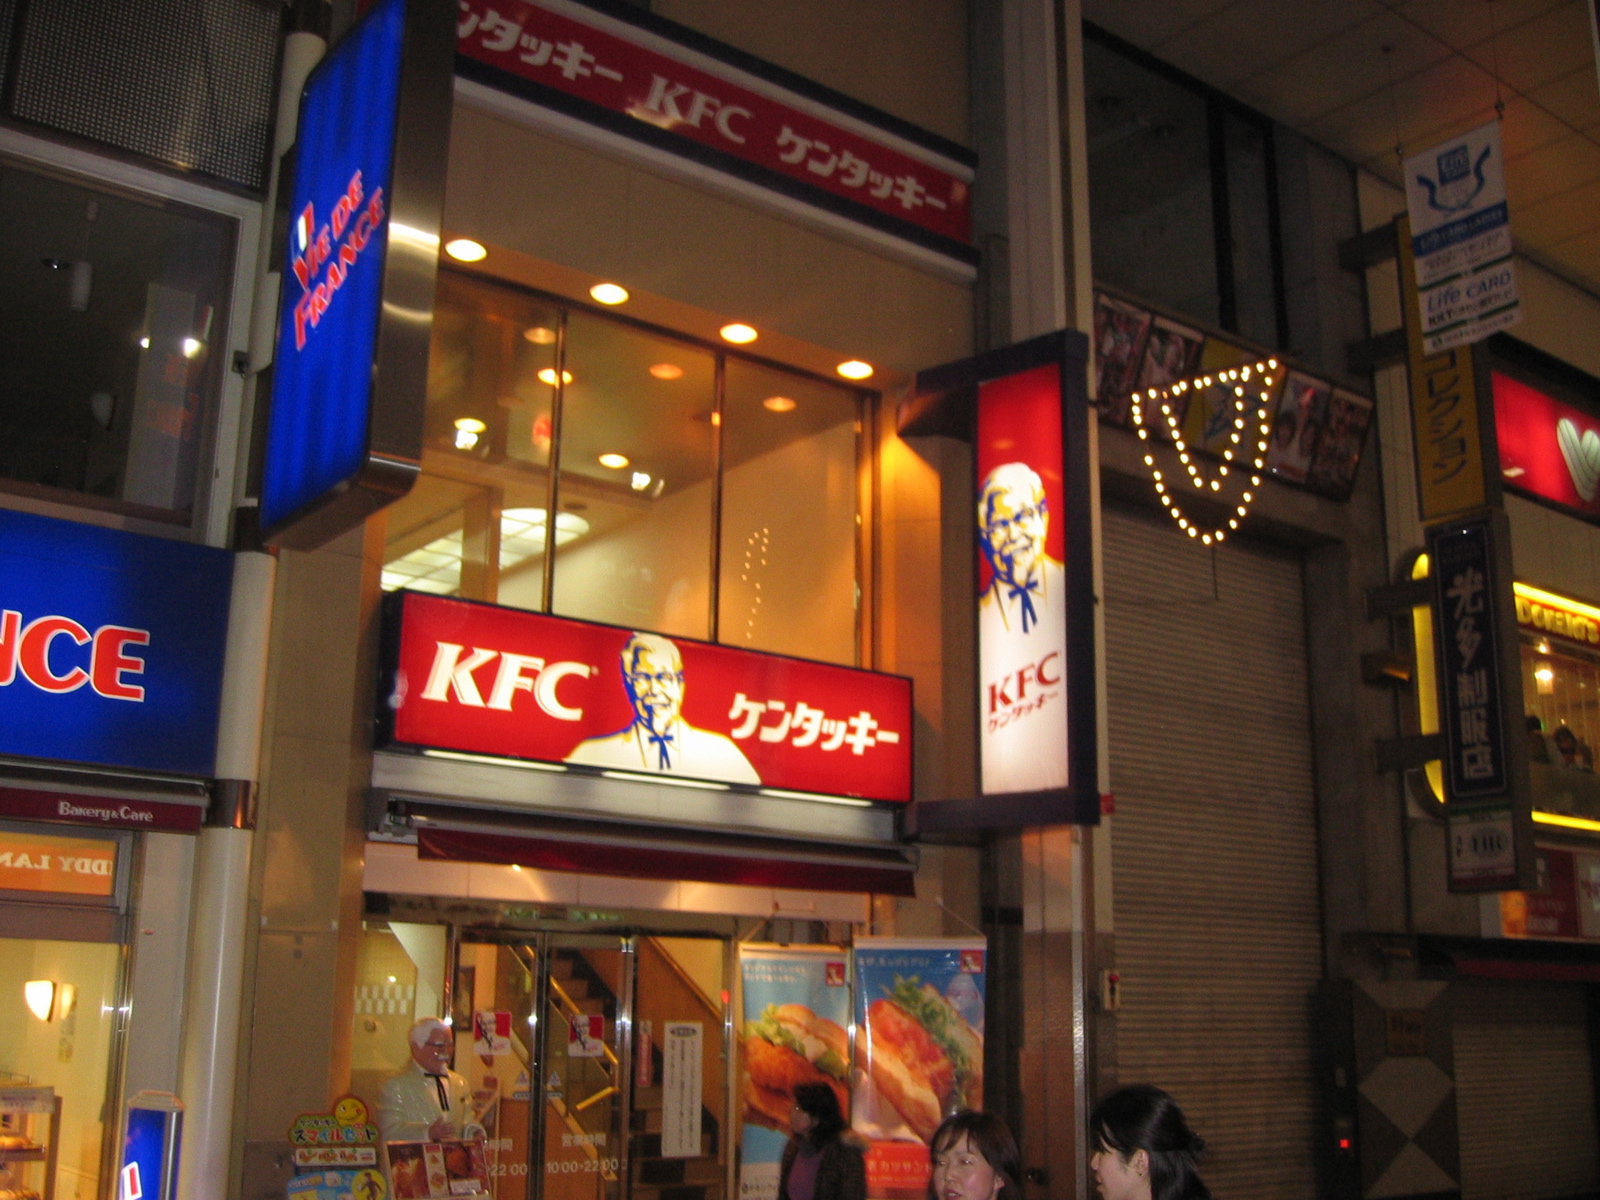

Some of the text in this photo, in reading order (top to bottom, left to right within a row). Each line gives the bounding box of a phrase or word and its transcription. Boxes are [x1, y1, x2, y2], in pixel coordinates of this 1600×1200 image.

[643, 73, 756, 144] KFC
[776, 125, 947, 211] ケンタッキー
[293, 186, 386, 352] FRANCE
[1464, 271, 1512, 299] CARD
[420, 640, 900, 757] KFC ケンタッキー
[988, 650, 1061, 715] KFC
